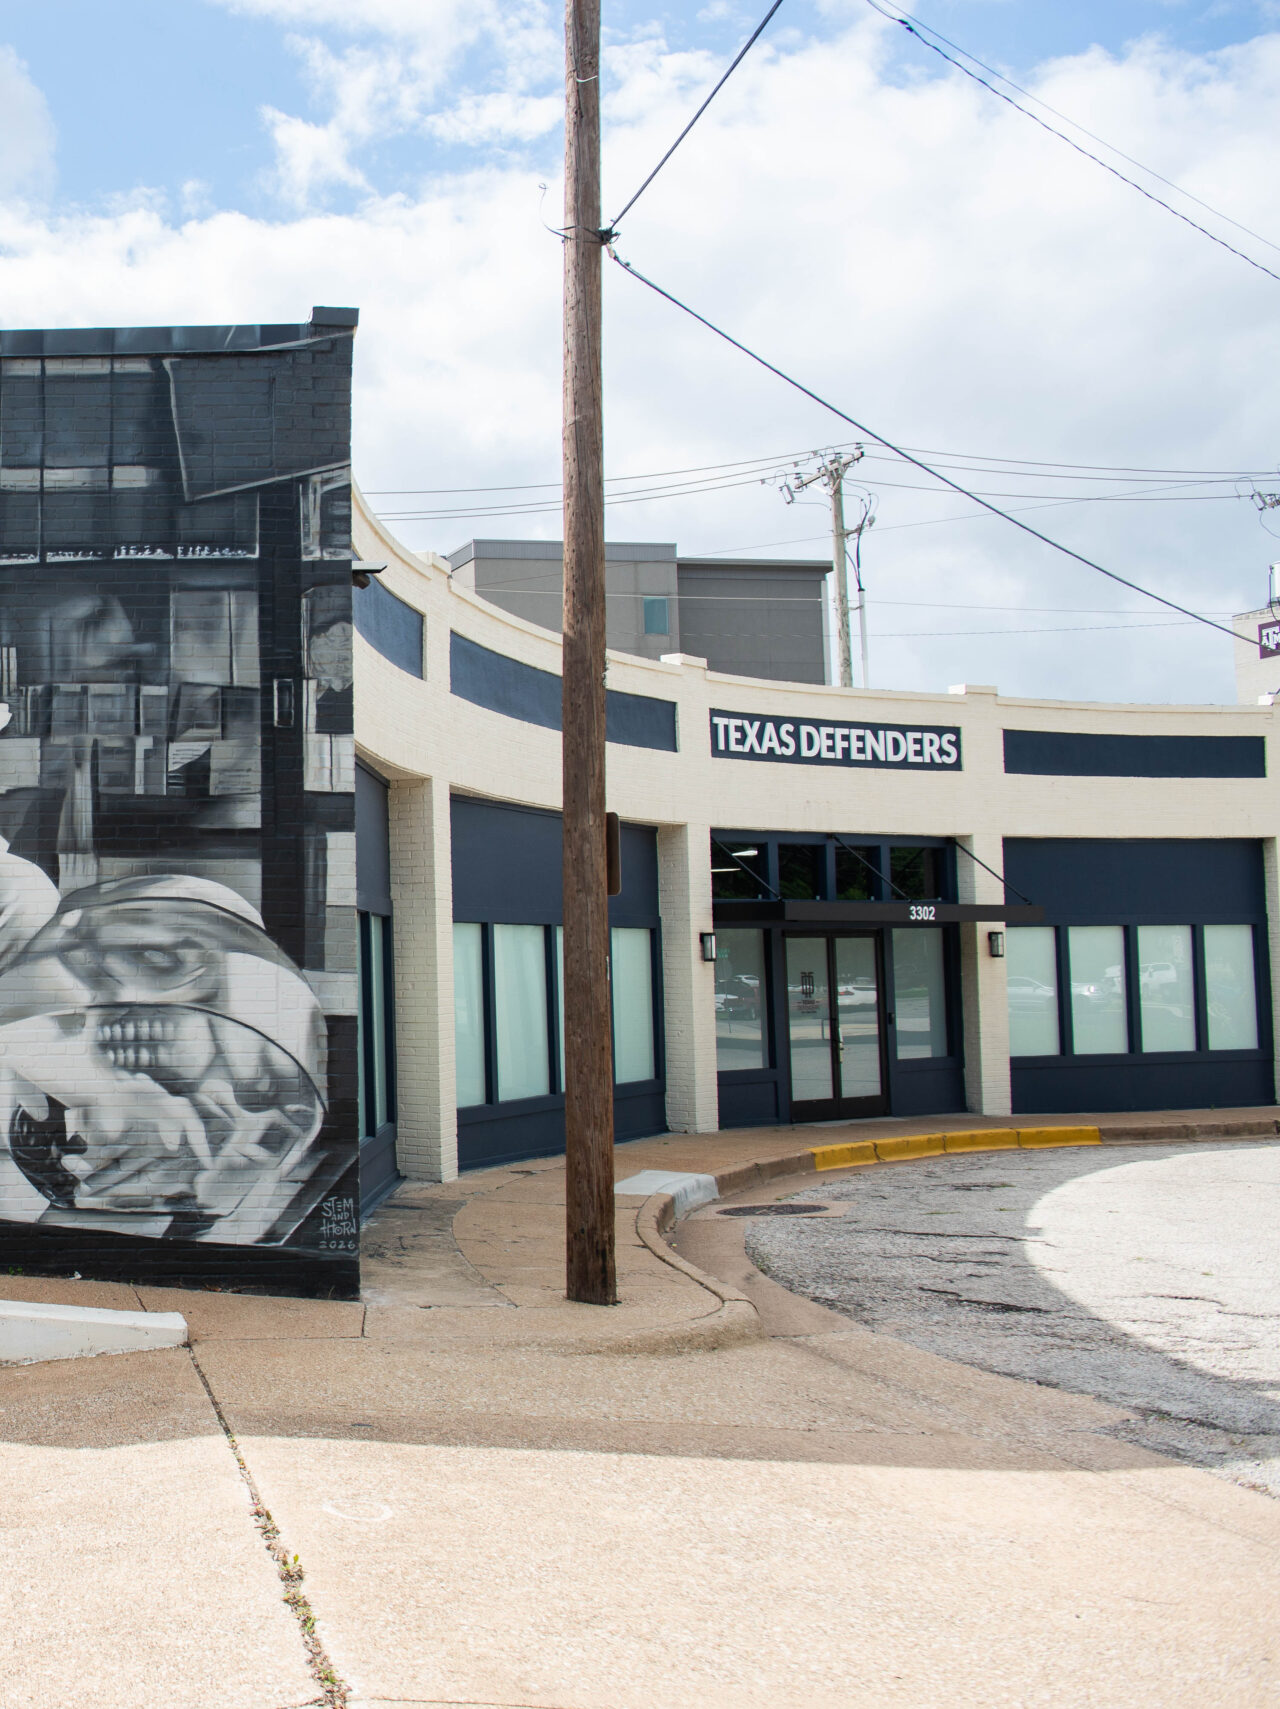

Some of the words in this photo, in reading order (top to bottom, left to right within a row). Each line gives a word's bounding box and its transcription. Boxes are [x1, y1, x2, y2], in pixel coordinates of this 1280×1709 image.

[712, 716, 796, 756] TEXAS
[799, 725, 958, 764] DEFENDERS
[910, 905, 936, 920] 3302
[331, 1212, 350, 1221] AND
